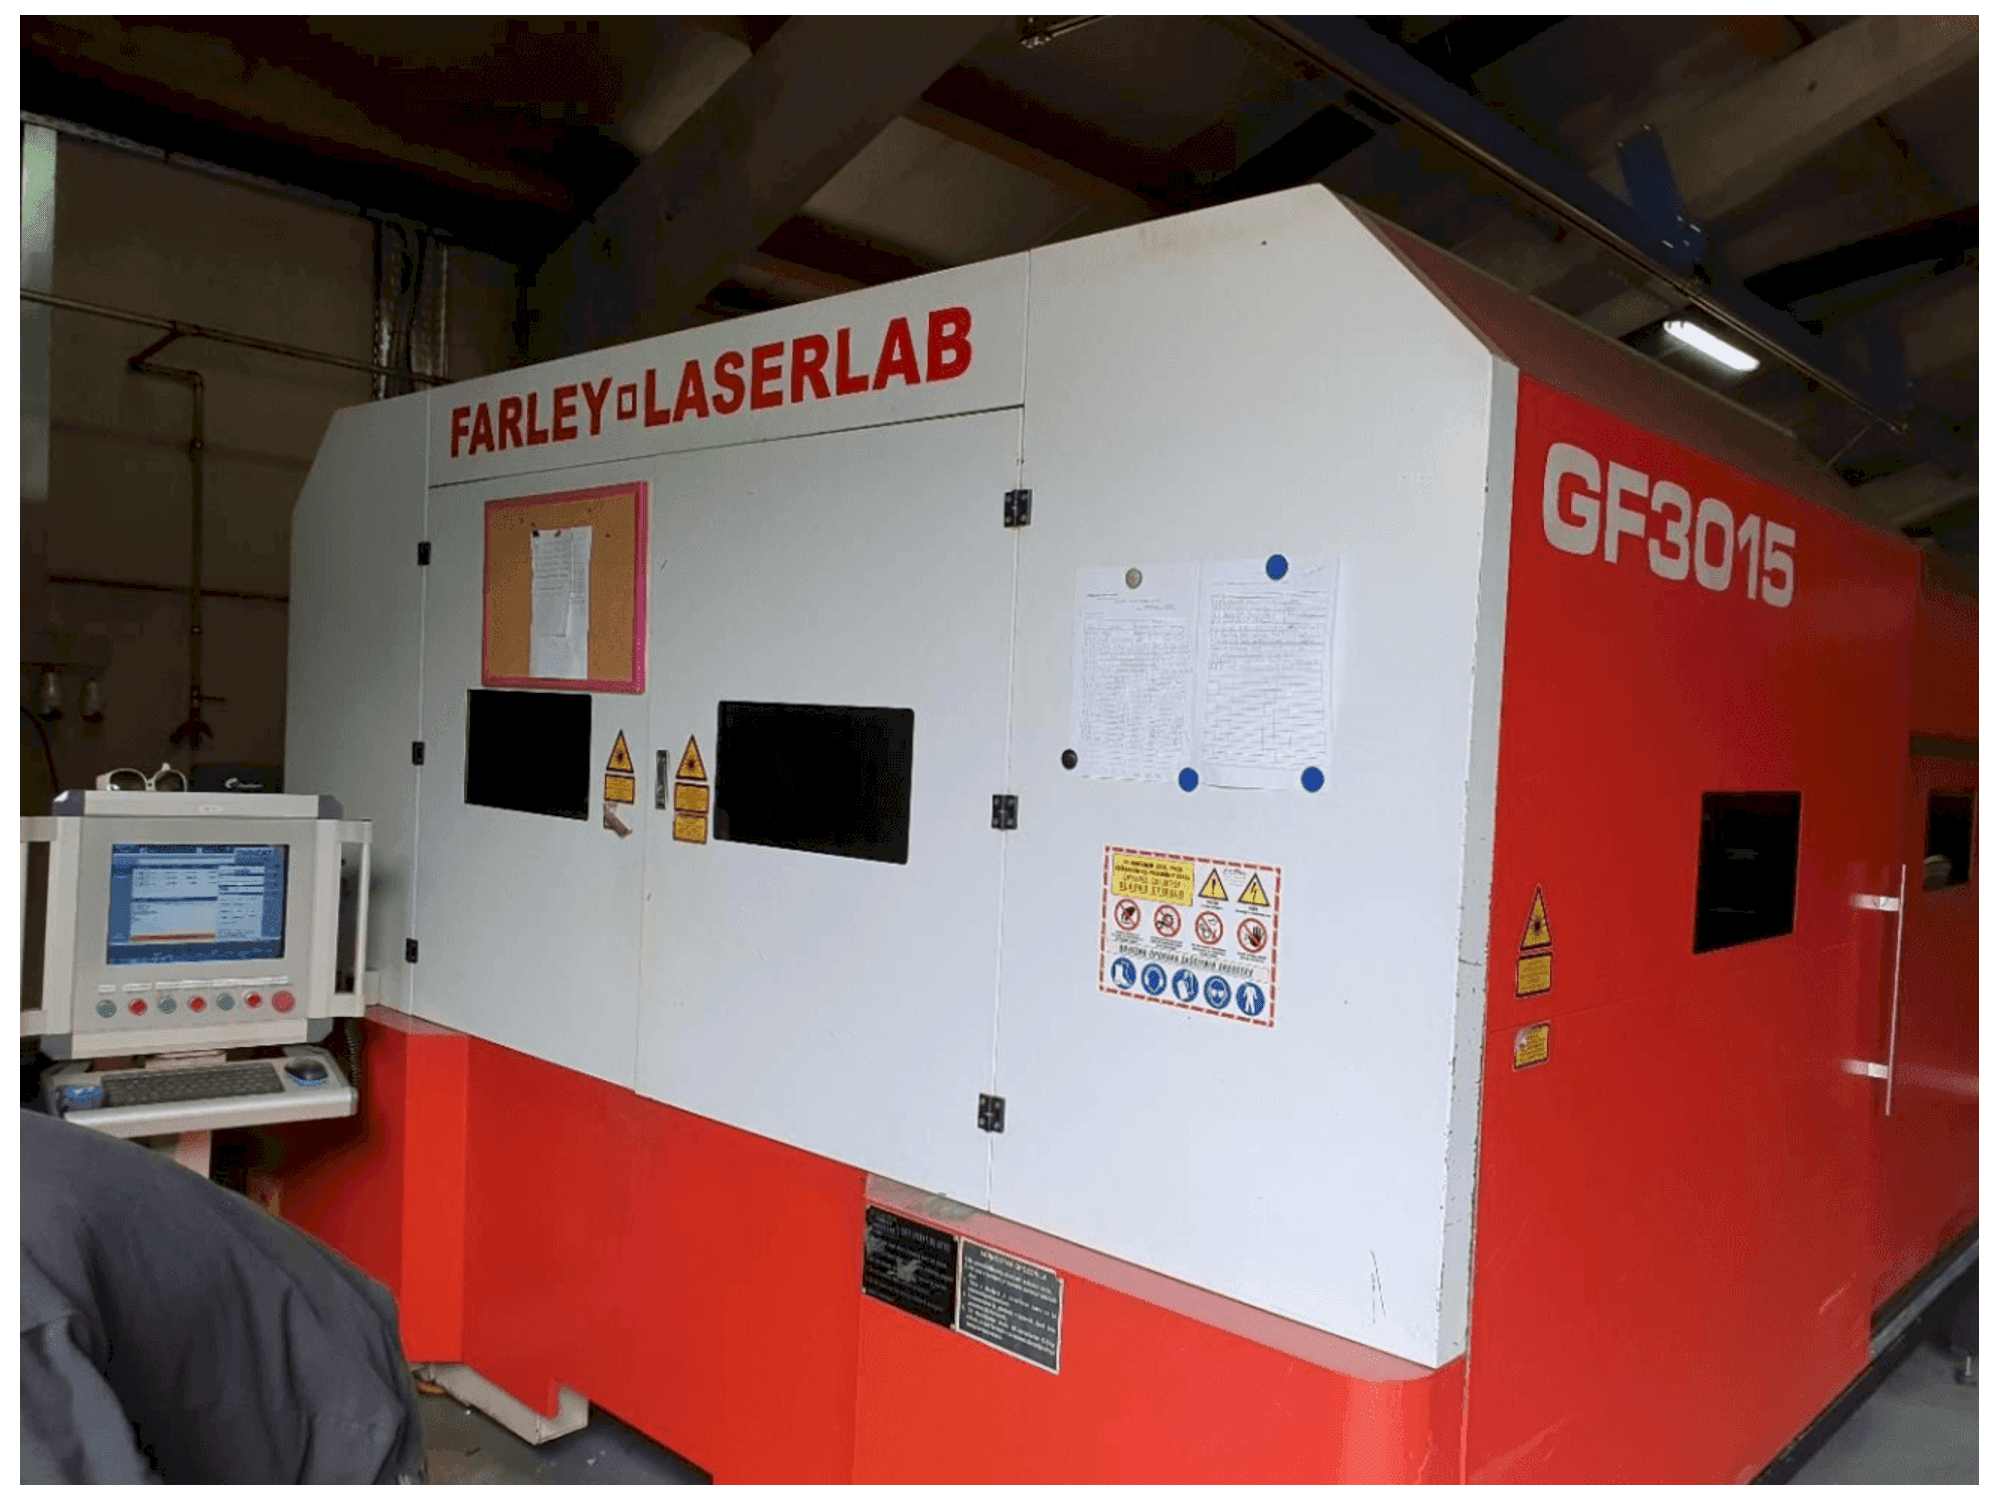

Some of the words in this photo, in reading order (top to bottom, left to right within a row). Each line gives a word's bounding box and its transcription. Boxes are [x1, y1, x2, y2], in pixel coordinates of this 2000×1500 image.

[450, 375, 614, 458] FARLEY
[644, 305, 974, 428] LASERLAB
[1542, 441, 1797, 609] GF3015
